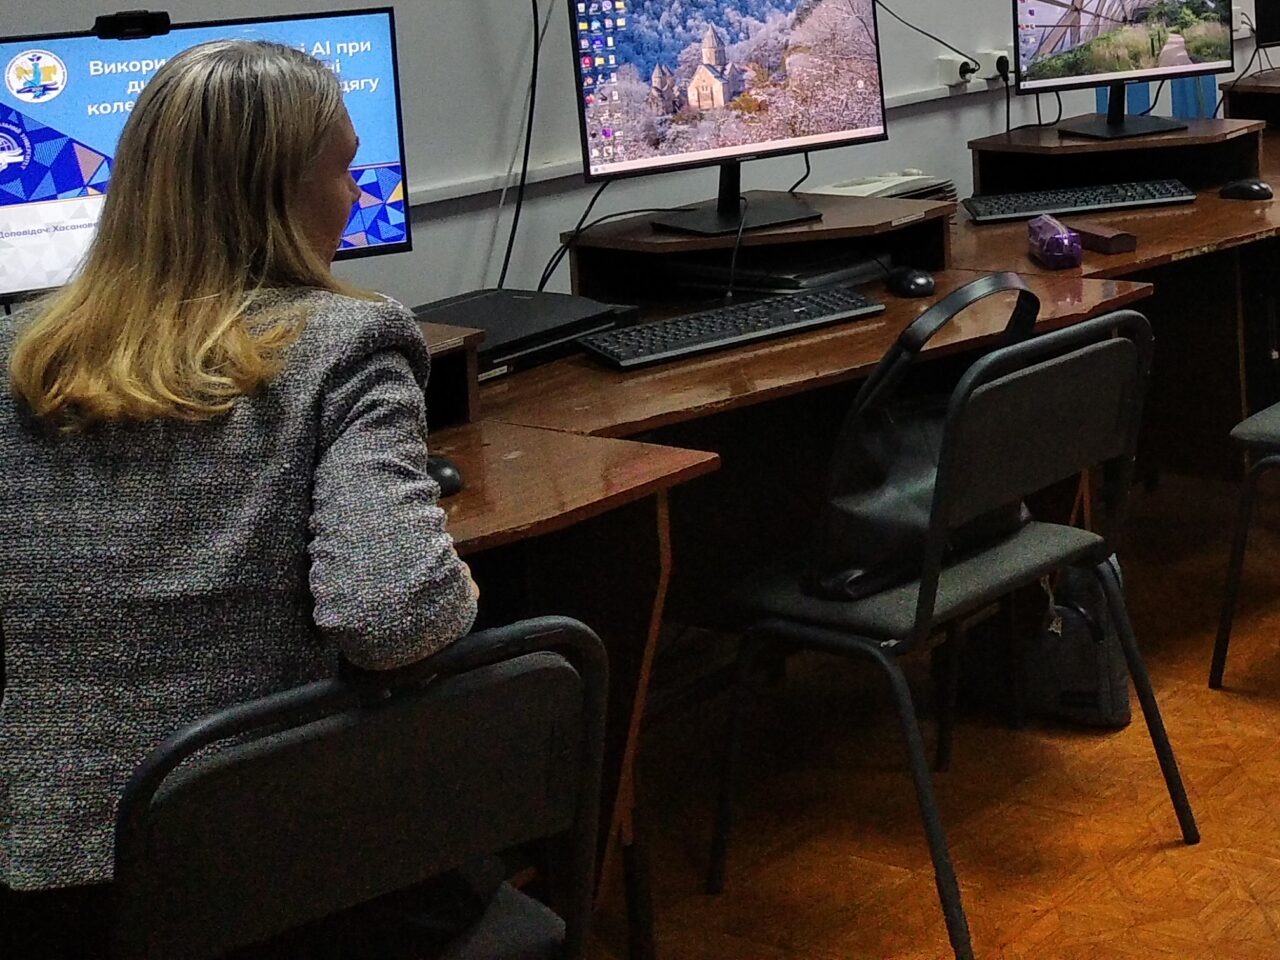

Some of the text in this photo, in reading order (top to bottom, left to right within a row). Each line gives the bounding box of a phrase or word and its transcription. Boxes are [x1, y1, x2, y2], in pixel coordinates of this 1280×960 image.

[336, 40, 371, 57] при
[89, 58, 166, 76] Викори
[339, 78, 379, 93] дягу
[87, 100, 135, 116] коле
